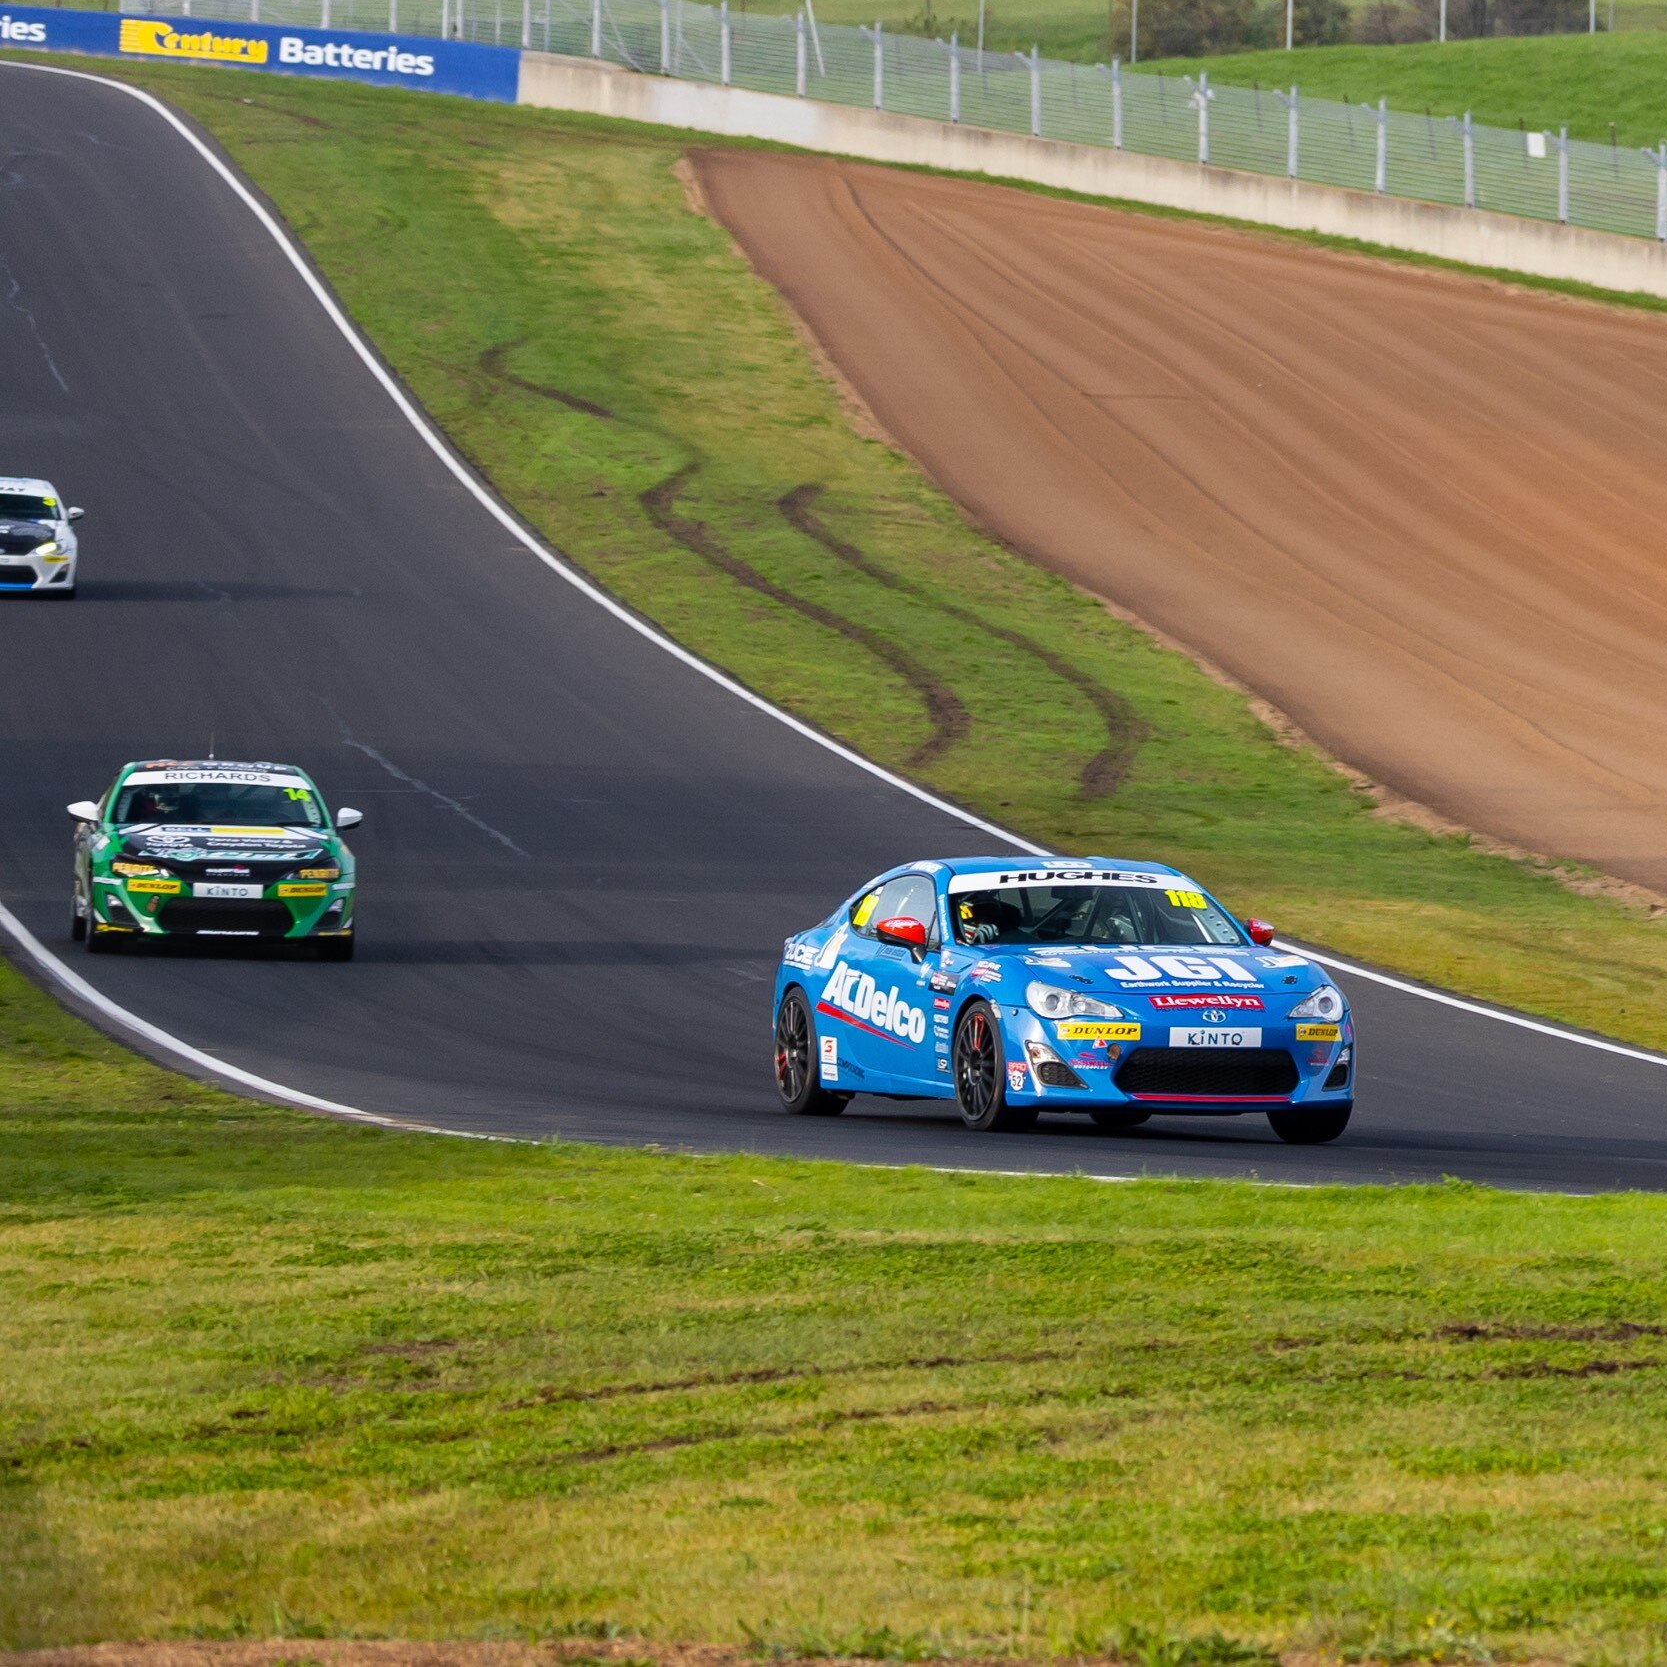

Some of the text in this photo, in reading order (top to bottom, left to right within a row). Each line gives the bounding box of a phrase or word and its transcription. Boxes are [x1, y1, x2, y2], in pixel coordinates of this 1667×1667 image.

[120, 19, 434, 76] Century Batteries
[164, 772, 271, 783] RICHARDS
[999, 871, 1158, 884] HUGHES
[1164, 889, 1207, 910] 118
[1104, 955, 1258, 982] JGI
[1120, 980, 1171, 988] Earthwork
[1173, 980, 1212, 988] Supplier
[1222, 980, 1265, 989] Recycler
[1153, 995, 1260, 1007] Llewellyn
[1073, 1027, 1138, 1035] DUNLOP
[1308, 1028, 1339, 1037] DUNLOP
[1012, 1075, 1022, 1087] 52
